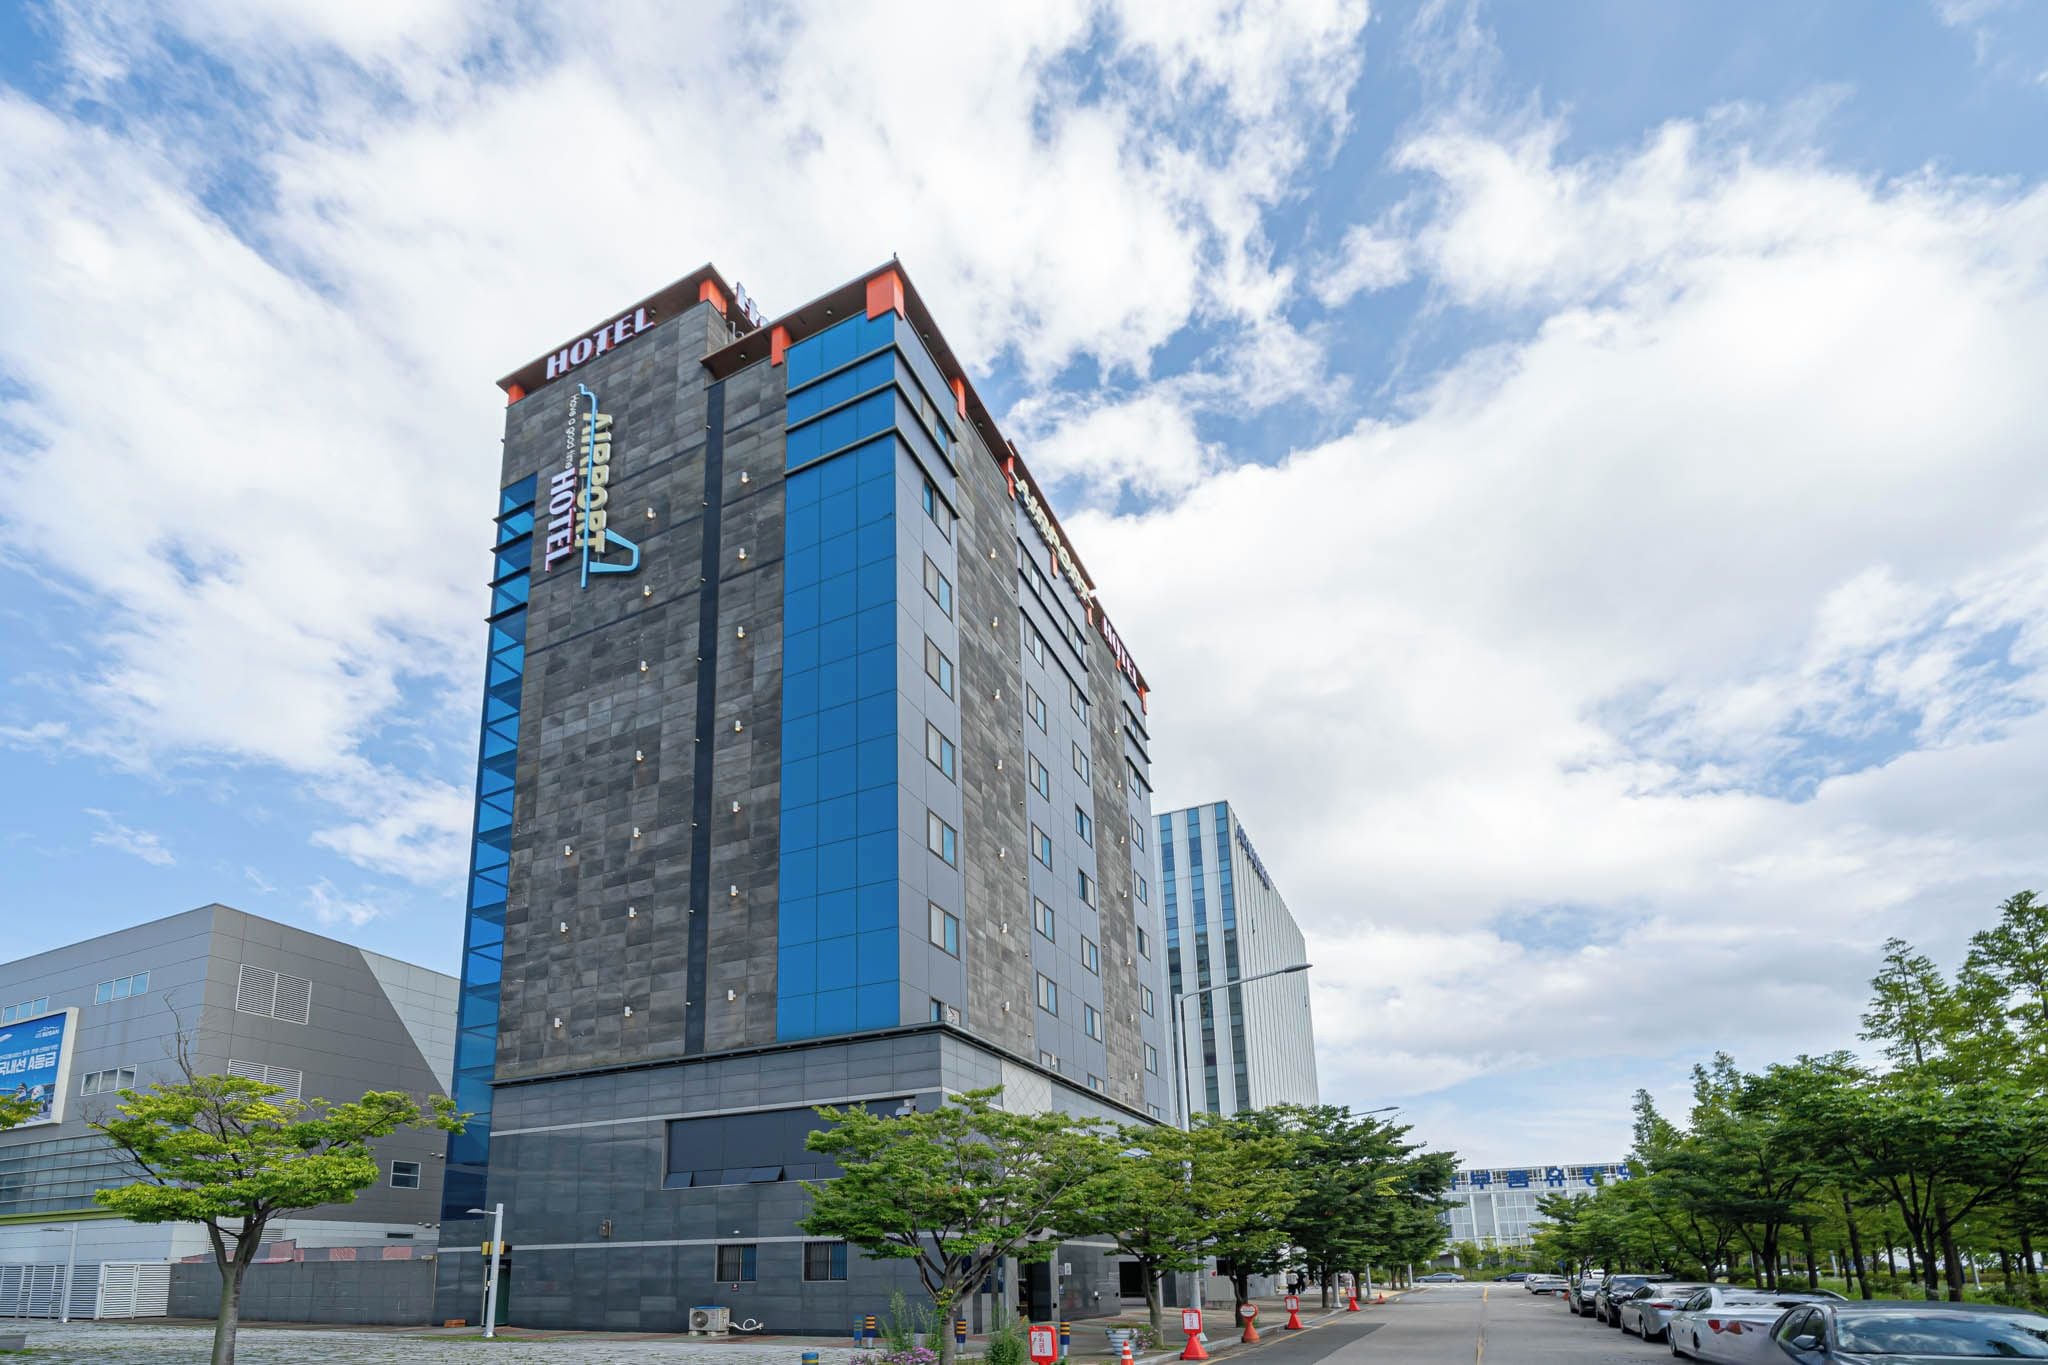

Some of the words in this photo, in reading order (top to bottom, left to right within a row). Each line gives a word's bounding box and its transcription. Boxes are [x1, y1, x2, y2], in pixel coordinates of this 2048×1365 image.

[546, 307, 656, 380] HOTEL
[565, 449, 576, 469] time
[566, 426, 576, 449] good
[574, 412, 613, 553] AIRPORT
[545, 467, 577, 573] HOTEL
[1015, 479, 1092, 605] AIRPORT
[1102, 615, 1140, 690] HOTEL
[28, 1051, 56, 1070] A등급
